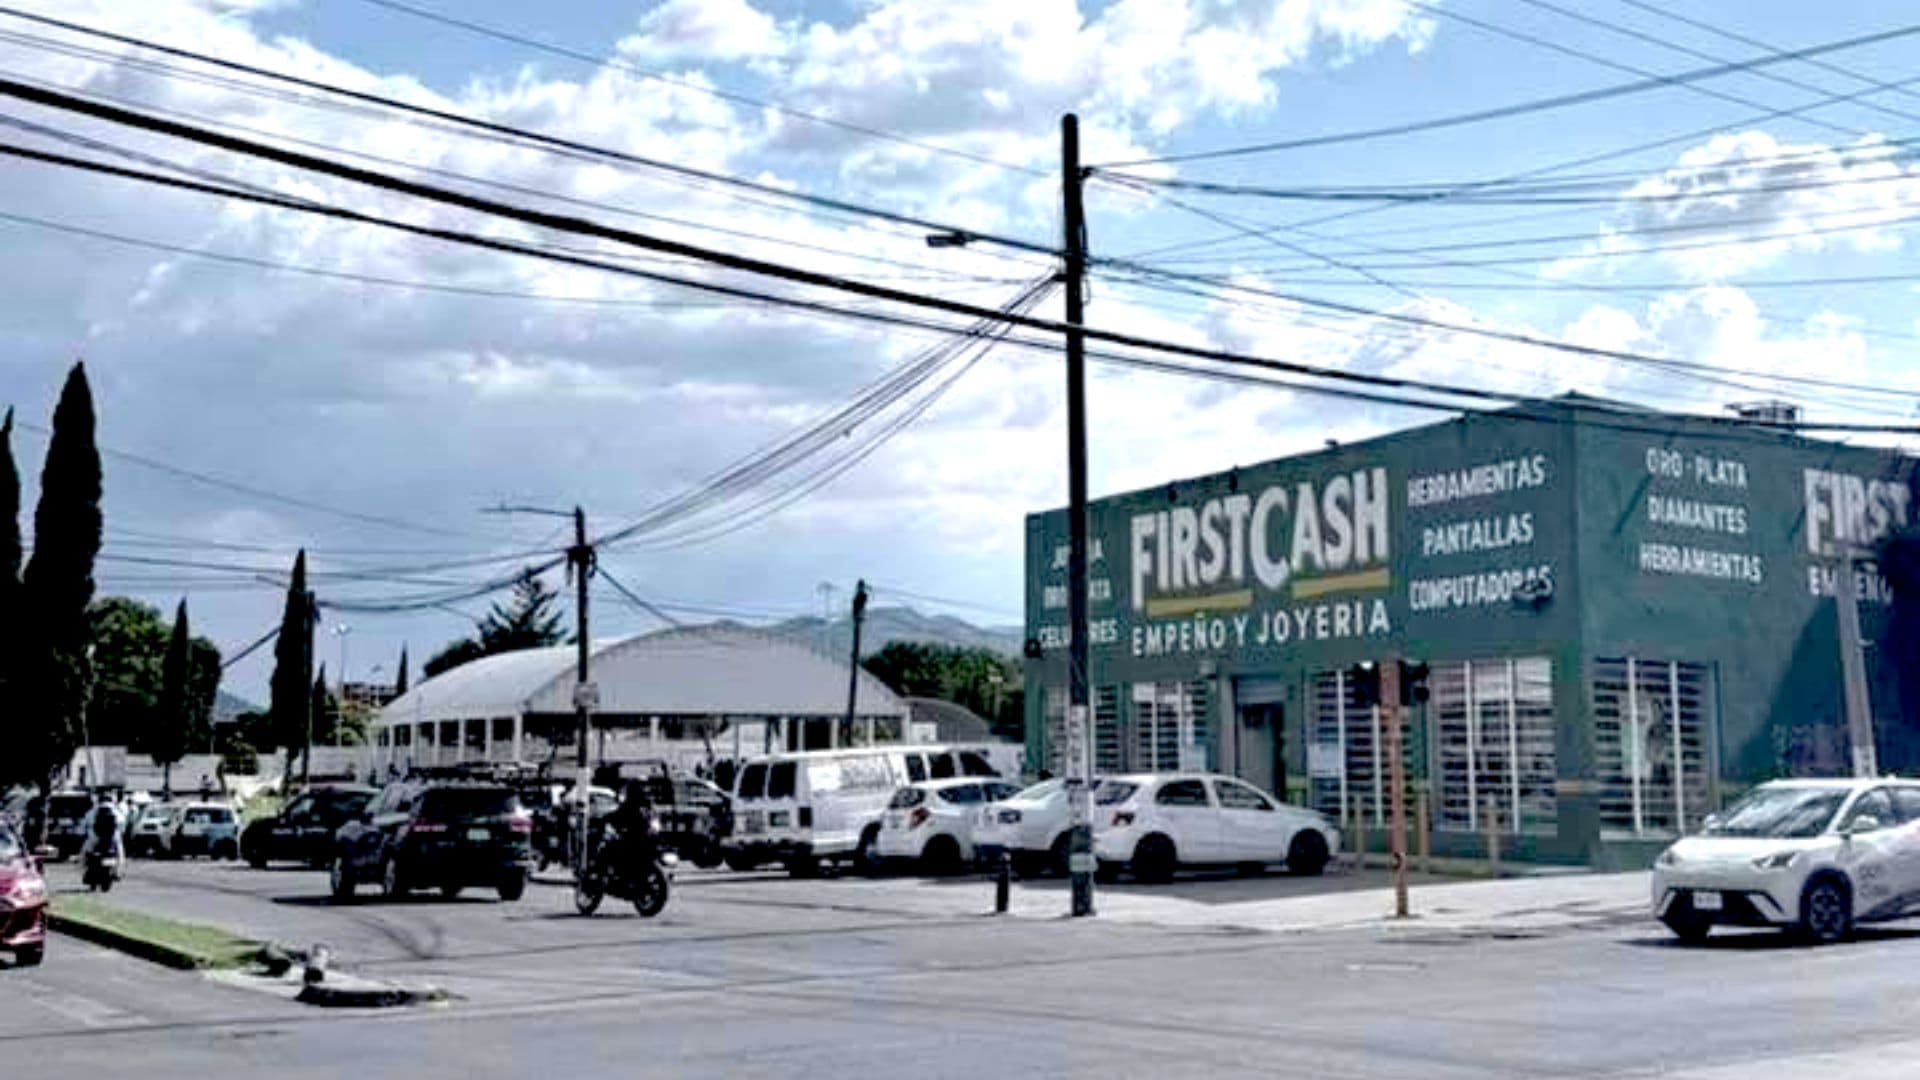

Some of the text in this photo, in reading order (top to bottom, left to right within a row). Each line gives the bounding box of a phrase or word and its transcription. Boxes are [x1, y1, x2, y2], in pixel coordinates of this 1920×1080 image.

[1407, 454, 1546, 507] HERRAMIENTAS
[1645, 447, 1748, 490] ORO PLATA
[1423, 511, 1535, 556] PANTALLAS
[1647, 495, 1748, 534] DIAMANTES
[1639, 542, 1762, 583] HERRAMIENTAS
[1132, 598, 1392, 657] EMPEÑO Y JOYERIA
